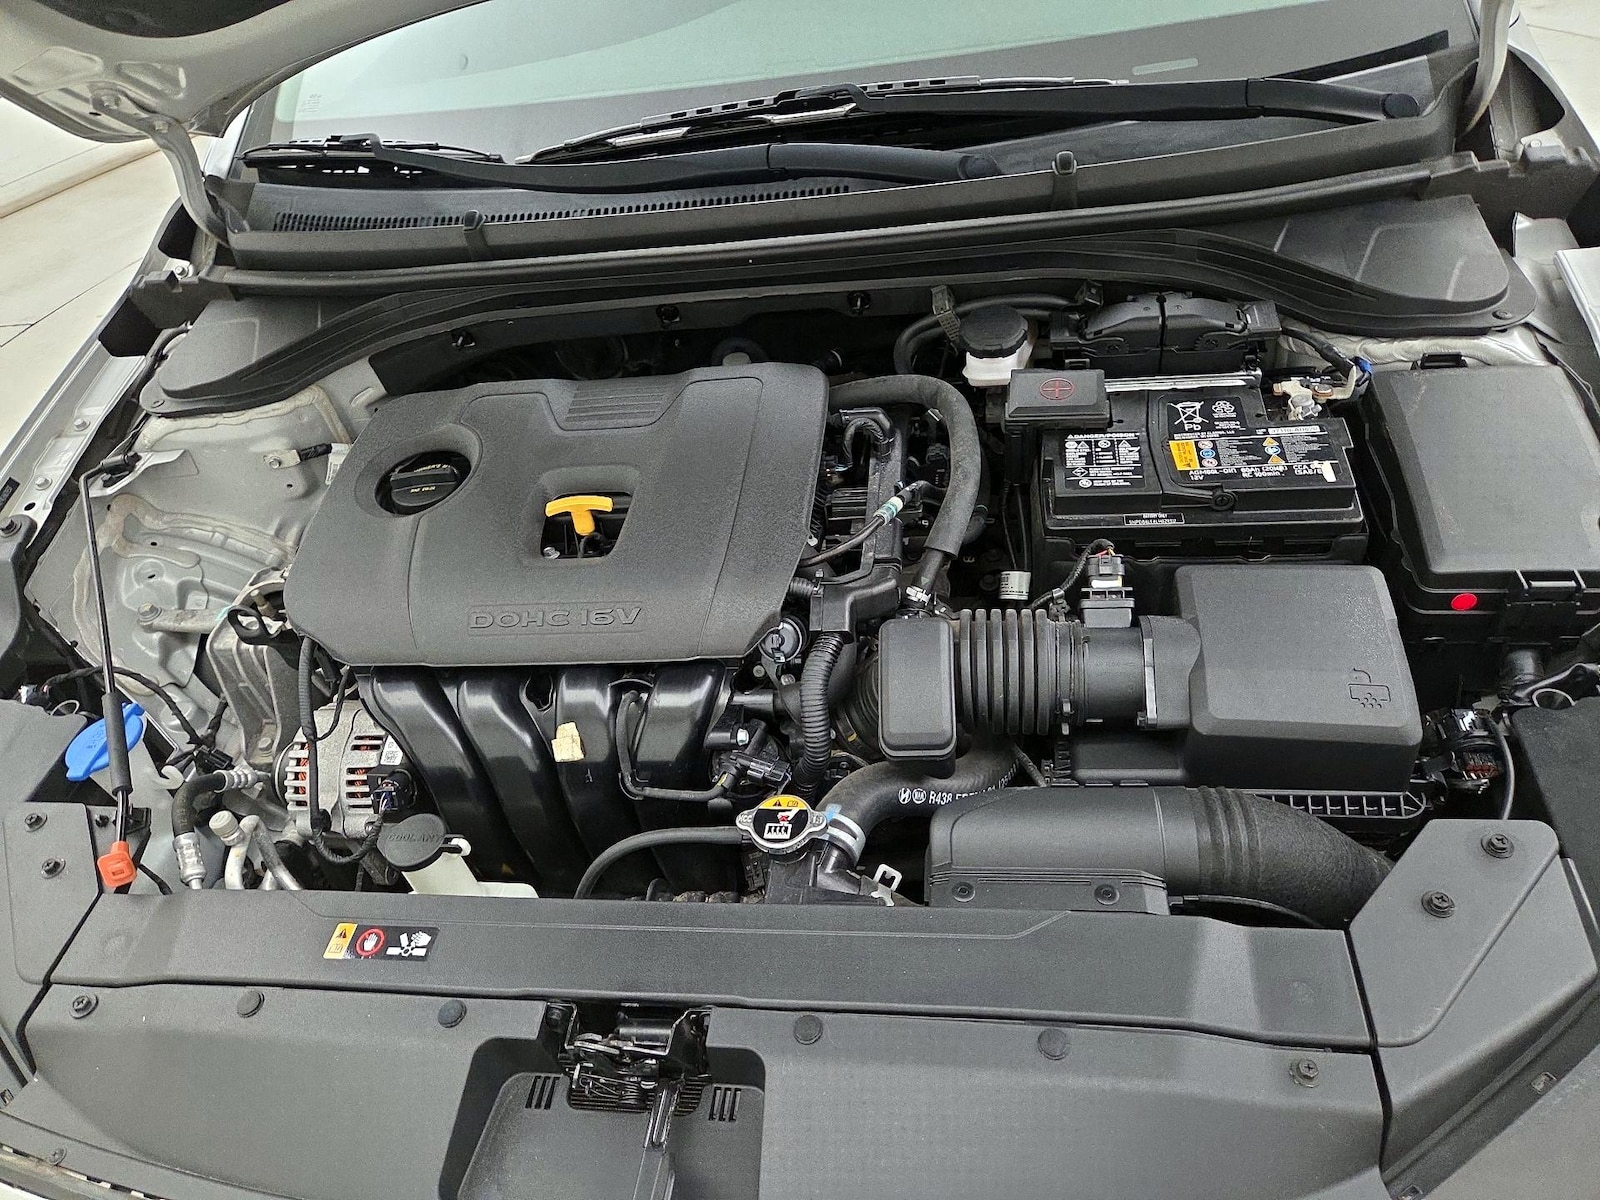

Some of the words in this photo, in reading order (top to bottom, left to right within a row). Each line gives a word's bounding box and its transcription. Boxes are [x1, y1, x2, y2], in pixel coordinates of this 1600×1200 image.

[1184, 423, 1201, 431] Pb
[469, 610, 570, 629] DOHC
[581, 606, 642, 627] 16V
